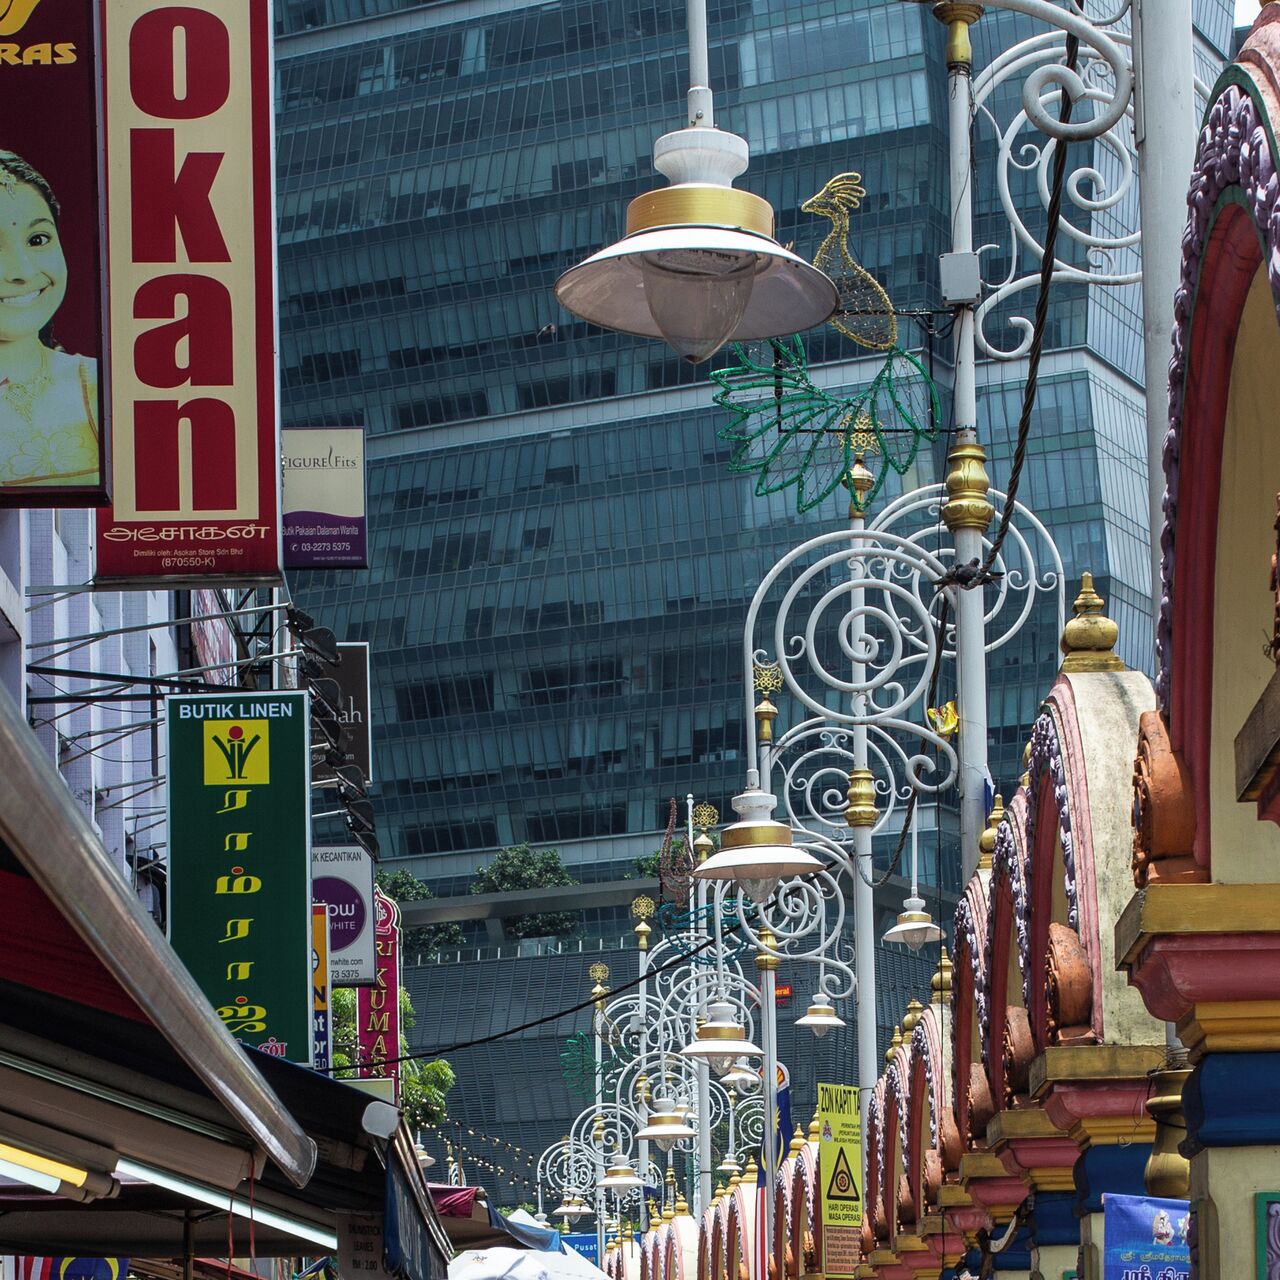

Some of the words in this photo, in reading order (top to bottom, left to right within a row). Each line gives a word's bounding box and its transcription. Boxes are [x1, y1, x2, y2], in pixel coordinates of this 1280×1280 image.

[335, 455, 357, 467] Fits
[103, 524, 270, 542] அசோகன்
[216, 548, 229, 556] Sdn
[301, 542, 331, 551] 03-2273
[332, 542, 351, 551] 5375
[161, 557, 216, 568] (870550-K)
[179, 704, 234, 719] BUTIK
[239, 703, 293, 718] LINEN
[320, 852, 362, 862] KECANTIKAN
[328, 903, 355, 917] ow
[341, 969, 360, 978] 5375
[821, 1086, 834, 1113] ZON
[840, 1204, 859, 1213] OPERASI
[828, 1213, 841, 1221] MASA
[353, 1241, 374, 1252] LEAVES
[574, 1243, 597, 1252] Pusat
[352, 1259, 360, 1270] RM
[365, 1260, 378, 1271] 2.00
